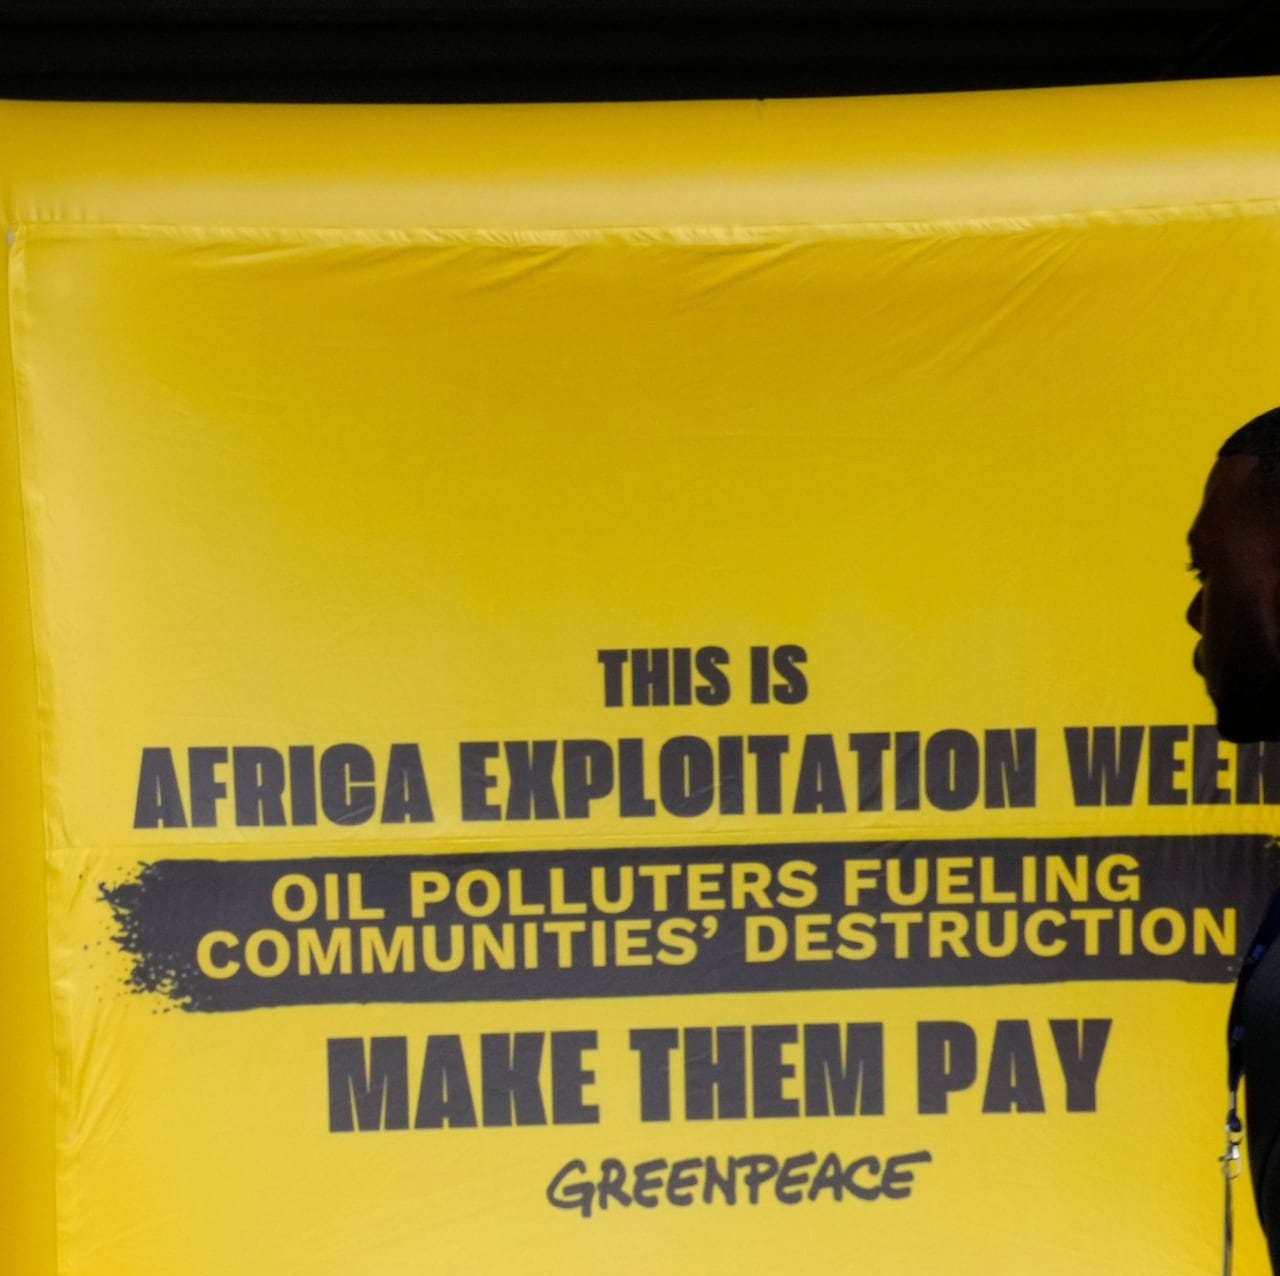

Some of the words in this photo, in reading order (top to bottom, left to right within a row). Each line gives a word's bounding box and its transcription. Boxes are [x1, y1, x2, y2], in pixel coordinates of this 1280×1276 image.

[597, 645, 731, 708] THIS
[750, 644, 809, 705] IS
[133, 743, 434, 829] AFRICA
[459, 727, 1037, 822] EXPLOITATION
[271, 872, 385, 923] OIL
[410, 860, 818, 915] POLLUTERS
[844, 853, 1140, 906] FUELING
[744, 906, 1236, 962] DESTRUCTION
[327, 1030, 600, 1133] MAKE
[629, 1022, 885, 1122] THEM
[916, 1018, 1113, 1115] PAY
[546, 1150, 932, 1217] GREENPEACE
